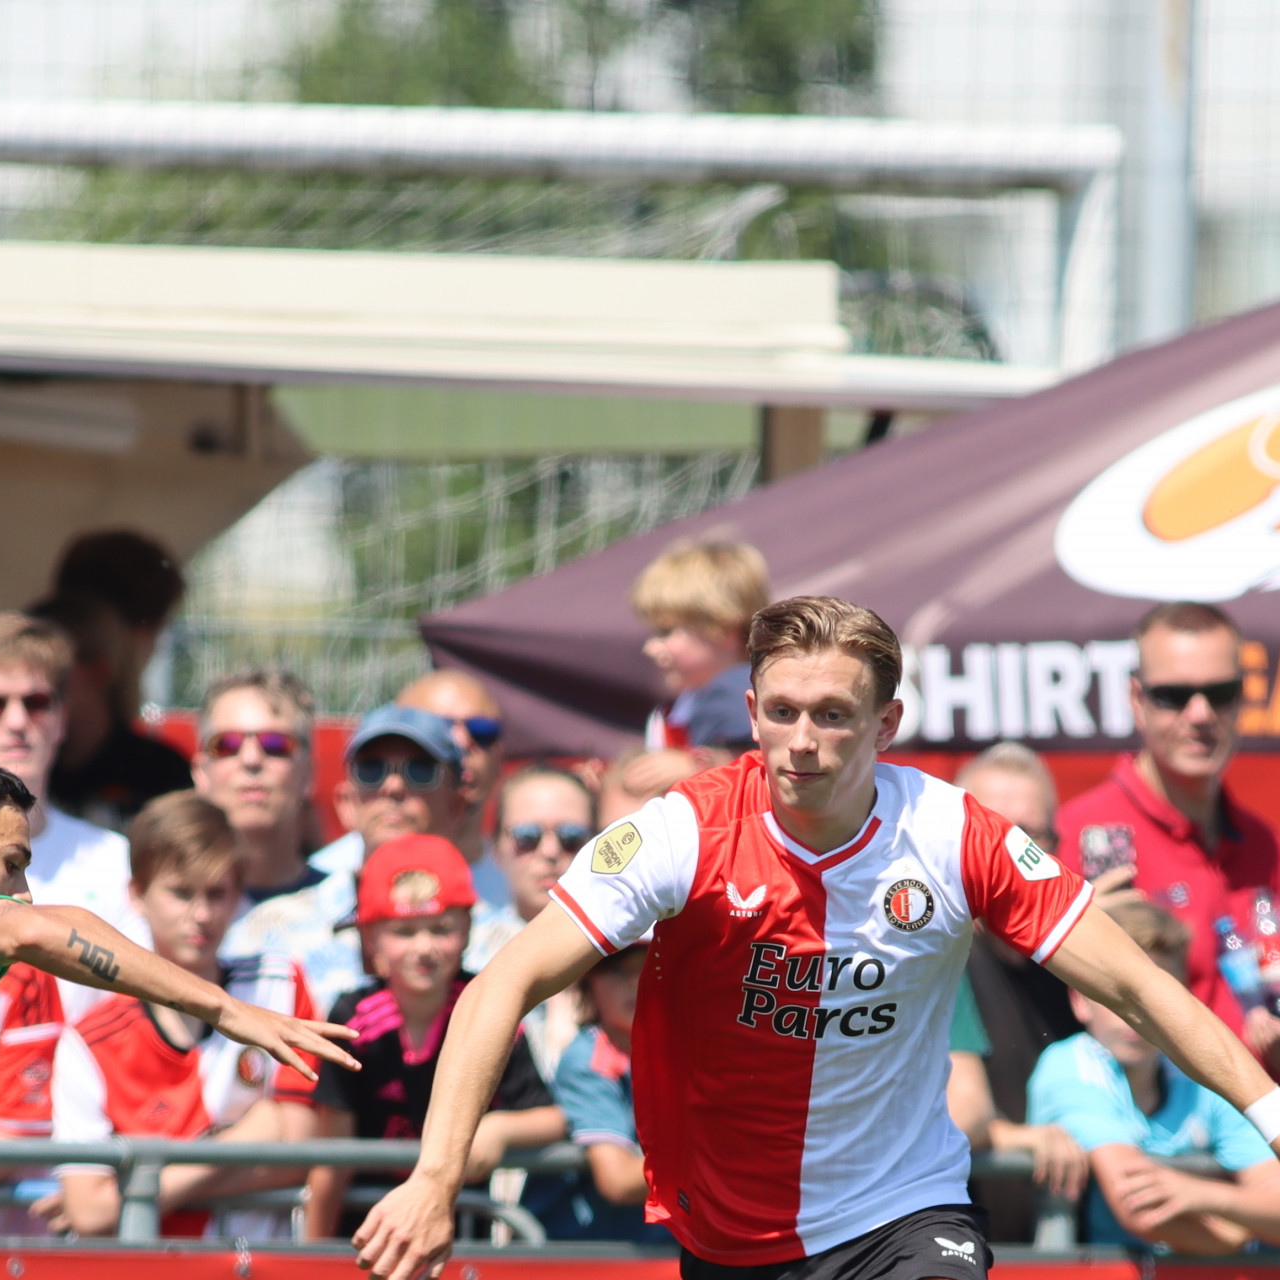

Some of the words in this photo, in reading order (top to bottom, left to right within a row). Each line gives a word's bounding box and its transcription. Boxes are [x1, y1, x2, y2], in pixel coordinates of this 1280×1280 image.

[1017, 841, 1044, 872] TOT
[742, 942, 886, 993] Euro
[736, 986, 898, 1041] Parcs
